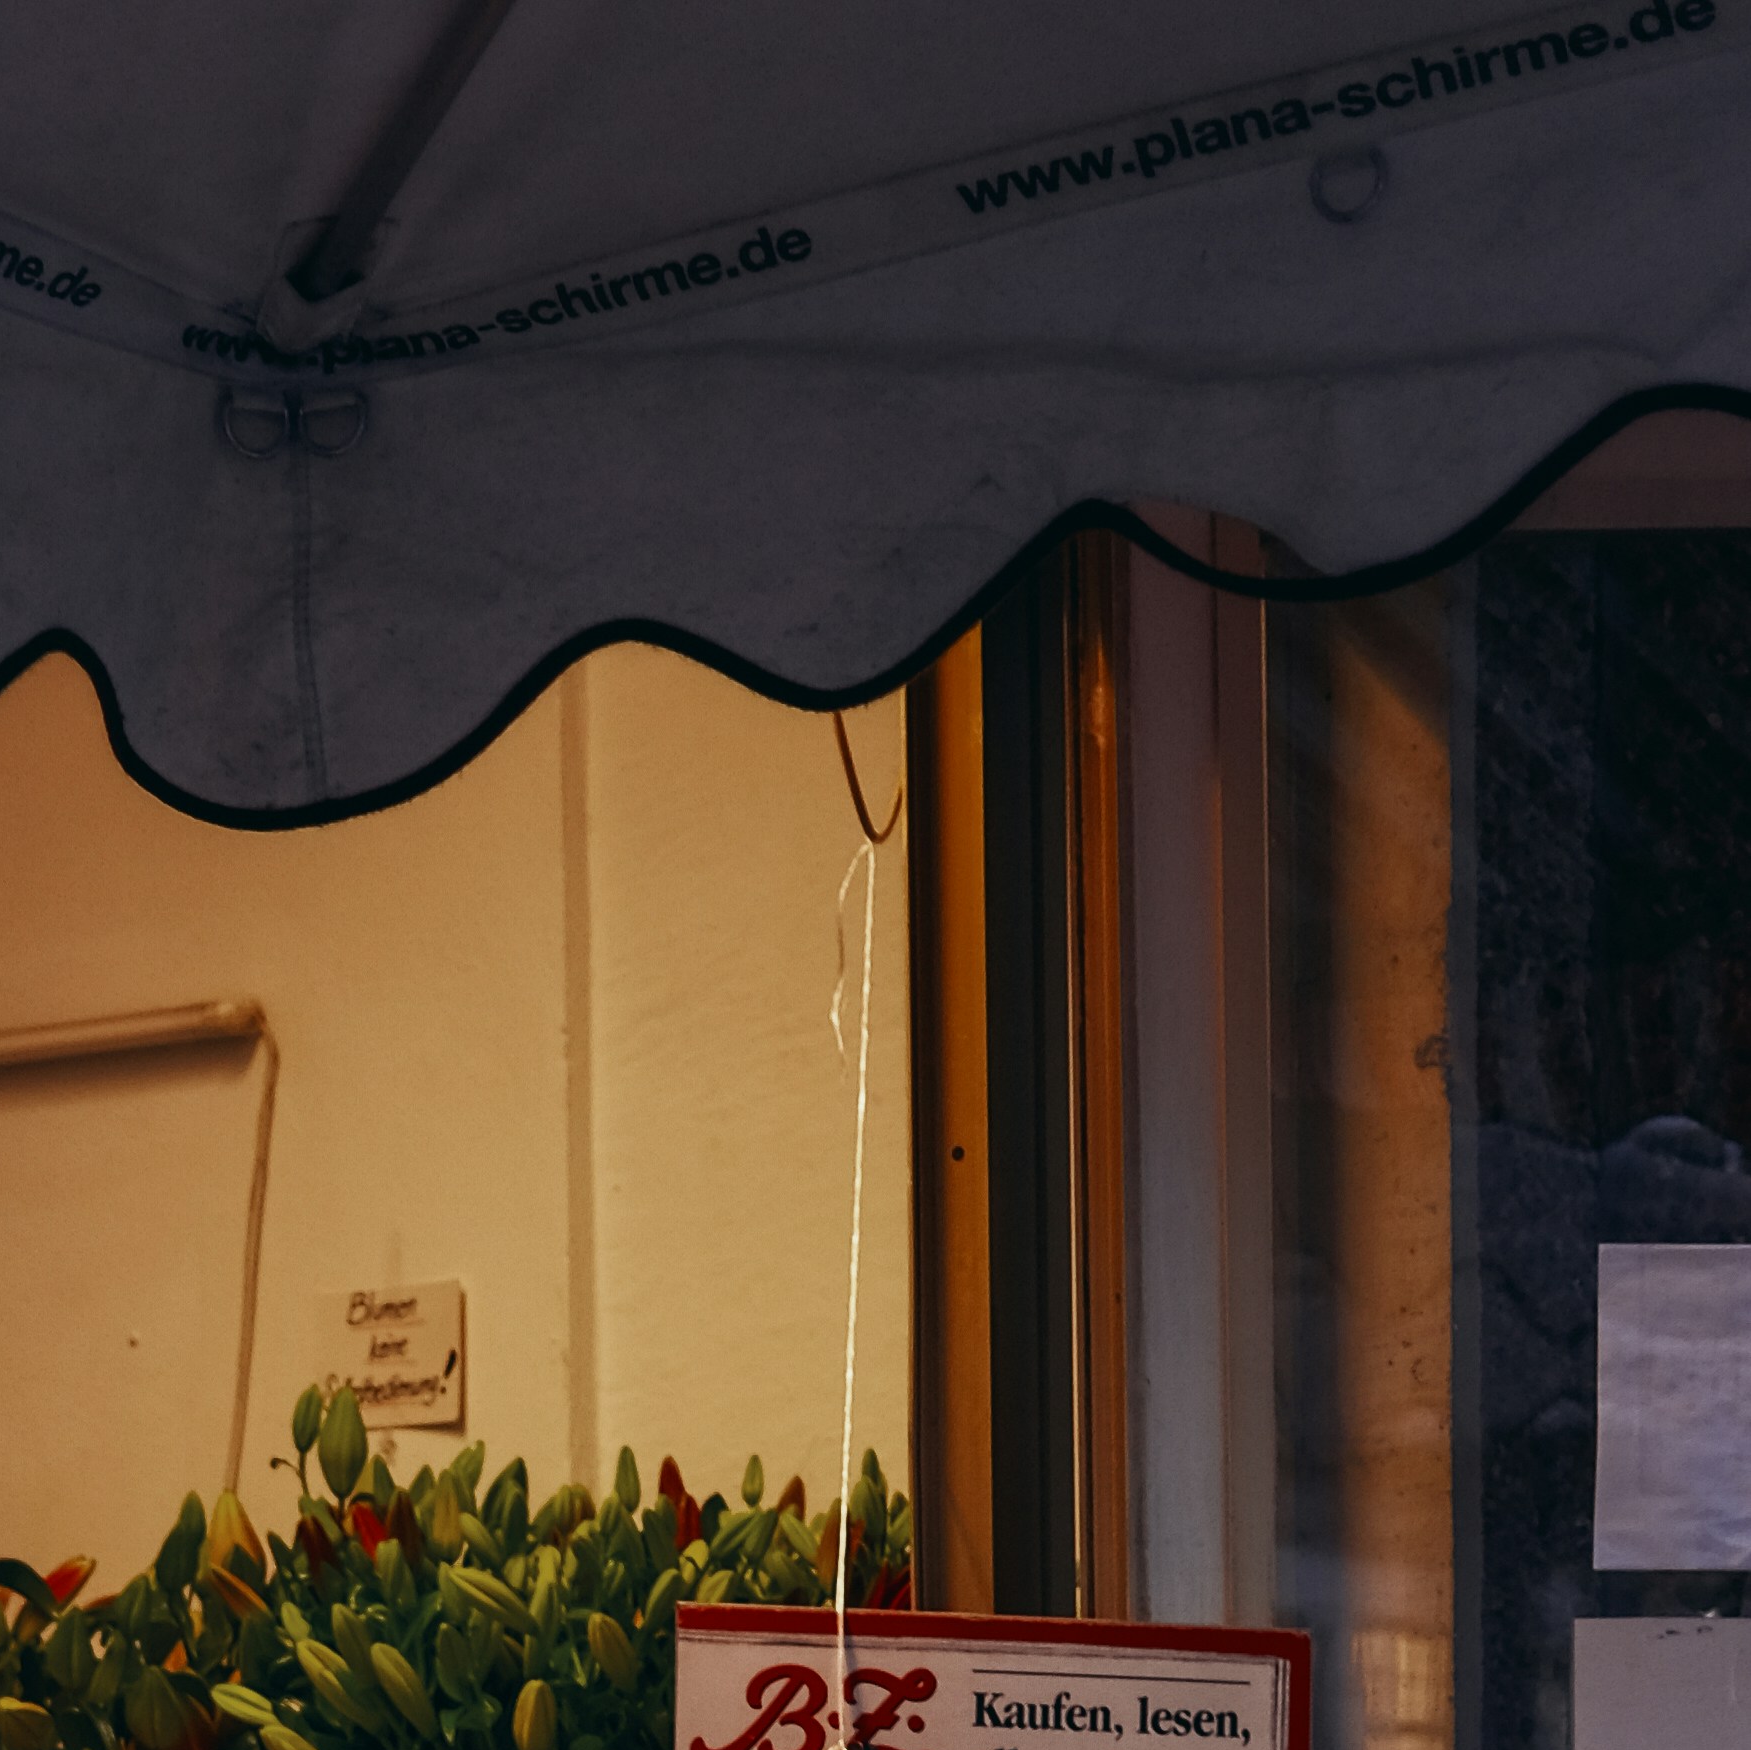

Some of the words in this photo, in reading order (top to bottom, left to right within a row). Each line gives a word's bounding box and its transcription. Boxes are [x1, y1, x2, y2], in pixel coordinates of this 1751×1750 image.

[956, 0, 1717, 214] www.plana-schirme.de
[972, 1692, 1124, 1736] Kaufen,
[1137, 1696, 1252, 1747] lesen,
